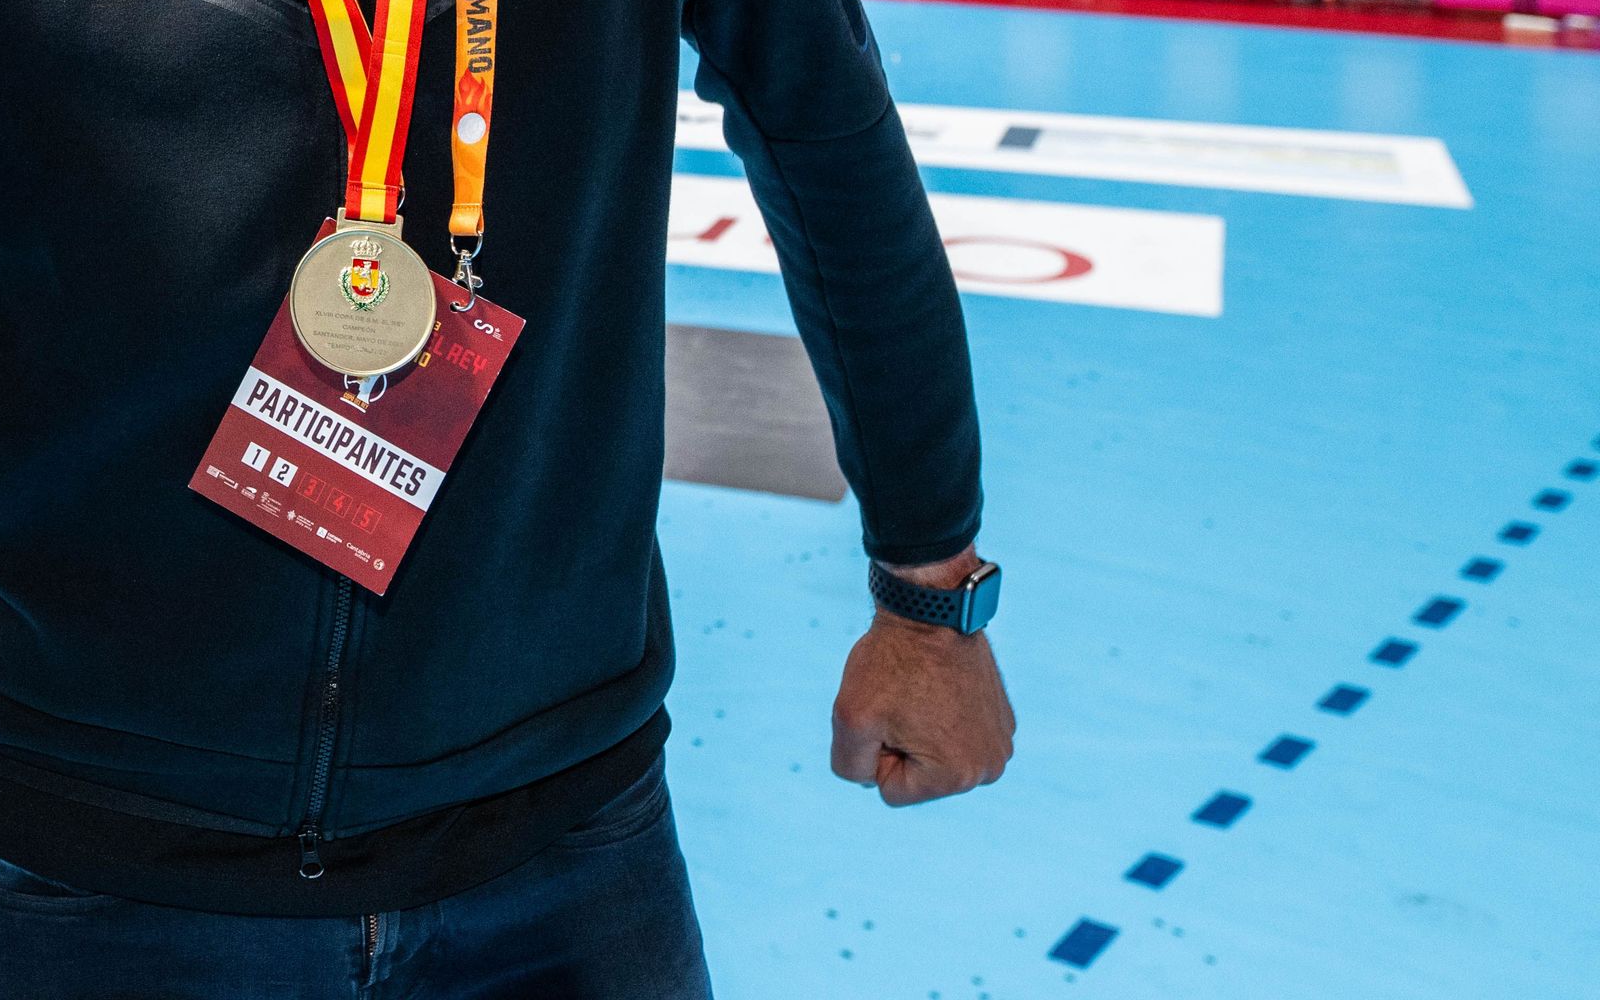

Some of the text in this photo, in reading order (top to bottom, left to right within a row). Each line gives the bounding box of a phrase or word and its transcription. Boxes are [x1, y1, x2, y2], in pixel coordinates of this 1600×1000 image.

[445, 343, 489, 377] REY
[246, 378, 427, 497] PARTICIPANTES
[250, 448, 374, 527] 1 2 3 4 5
